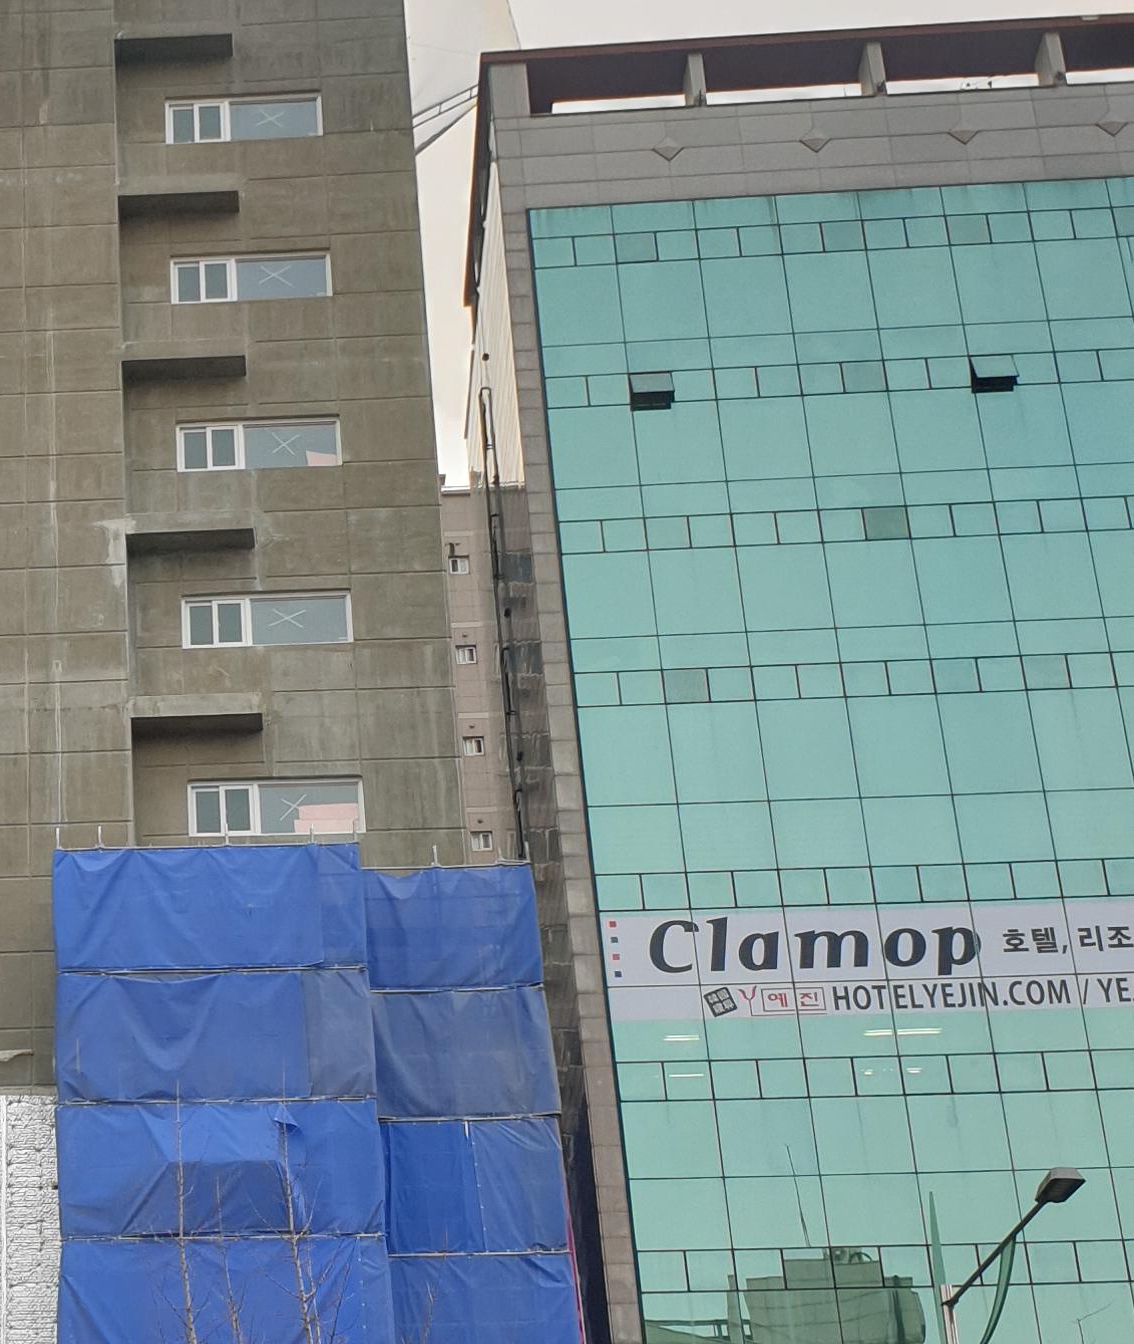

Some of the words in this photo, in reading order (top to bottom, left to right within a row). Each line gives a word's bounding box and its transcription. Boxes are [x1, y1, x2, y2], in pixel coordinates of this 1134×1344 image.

[648, 916, 982, 976] Clamop
[832, 978, 1072, 1013] HOTELYEJIN.COM
[1096, 976, 1134, 1004] YE
